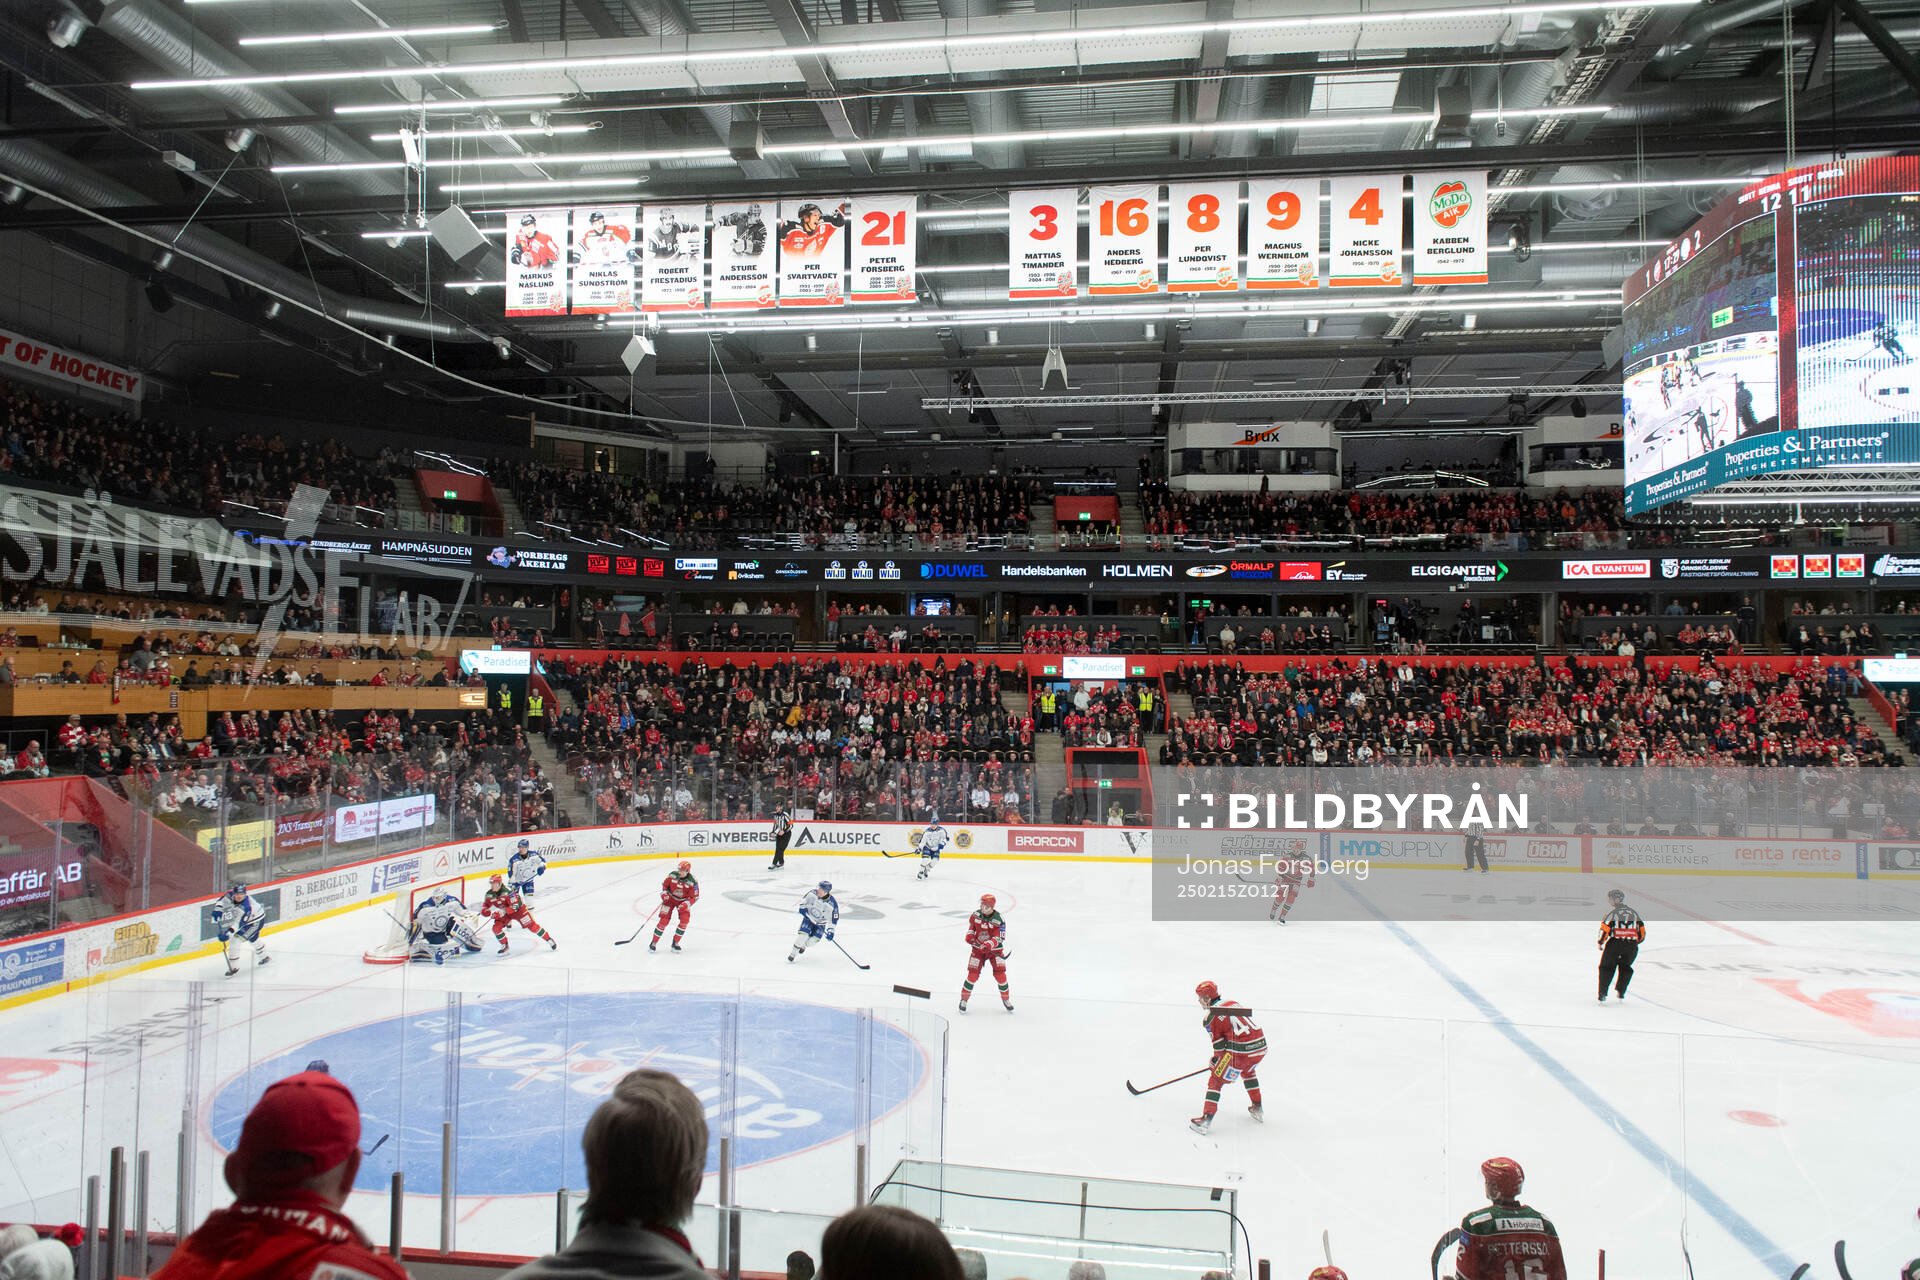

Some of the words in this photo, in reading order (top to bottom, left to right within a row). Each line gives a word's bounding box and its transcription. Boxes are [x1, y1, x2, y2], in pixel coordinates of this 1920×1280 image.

[1788, 185, 1809, 204] 11
[1348, 188, 1384, 226] 4
[1761, 192, 1782, 212] 12
[1100, 198, 1149, 236] 16
[1186, 194, 1220, 232] 8
[1266, 191, 1301, 230] 9
[1443, 207, 1460, 220] AIK
[861, 210, 906, 246] 21
[1028, 204, 1058, 240] 3
[14, 342, 48, 366] OF
[50, 352, 139, 394] HOCKEY
[1244, 428, 1280, 443] Brux
[1725, 444, 1780, 466] Properties
[1783, 436, 1805, 452] &
[382, 541, 472, 556] HAMPNÄSUDDEN
[516, 550, 568, 561] NORBERGS
[518, 559, 550, 569] ÅKERI
[552, 562, 566, 570] AB
[934, 564, 988, 578] DUWEL
[1001, 565, 1086, 576] Handelsbanken
[1103, 565, 1173, 577] HOLMEN
[1230, 560, 1274, 571] ÖRNALP
[1411, 565, 1495, 576] ELGIGANTEN
[1567, 564, 1589, 575] ICA
[1594, 564, 1644, 574] KVANTUM
[826, 569, 845, 579] WIJO
[852, 569, 872, 579] WIJO
[880, 569, 900, 579] WIJO
[1326, 569, 1342, 580] EY
[483, 656, 528, 666] Paradiset
[1082, 662, 1123, 671] Paradiset
[818, 832, 881, 845] ALUSPEC
[1016, 836, 1076, 847] BRORCON
[458, 847, 494, 864] WMC
[1528, 840, 1566, 858] ÖBM
[1628, 844, 1694, 854] KVALITETS
[1735, 847, 1784, 860] renta
[1792, 847, 1841, 861] renta
[1628, 855, 1709, 865] PERSIENNER
[296, 885, 304, 897] B.
[307, 872, 358, 894] BERGLUND
[295, 889, 344, 910] Entreprenad
[345, 885, 358, 896] AB
[1488, 1243, 1551, 1256] PETTERSSO
